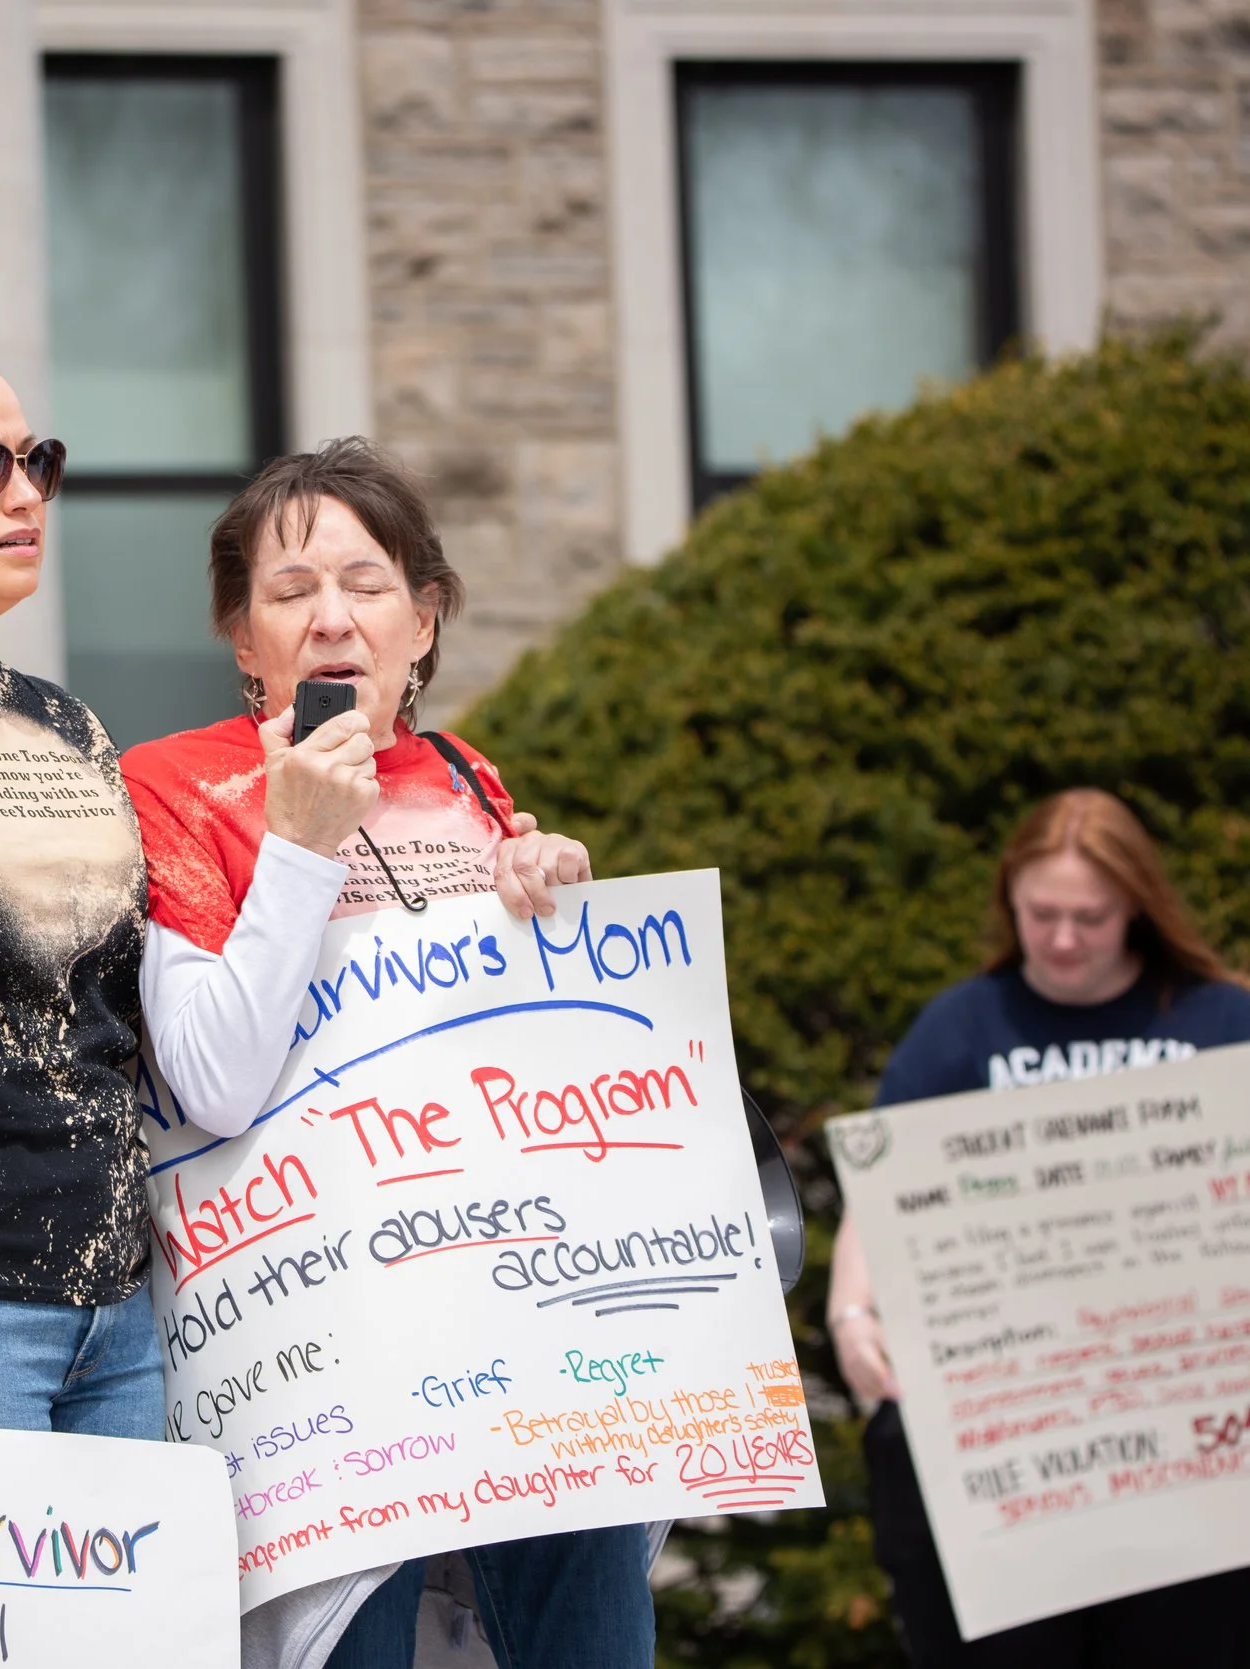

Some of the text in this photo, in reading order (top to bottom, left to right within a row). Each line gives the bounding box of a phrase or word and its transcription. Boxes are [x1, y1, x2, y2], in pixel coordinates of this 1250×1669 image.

[19, 750, 50, 763] Too
[33, 769, 84, 784] you're
[40, 787, 79, 800] with
[79, 789, 100, 798] us
[409, 840, 446, 854] Too
[290, 919, 507, 1051] urvivor's
[531, 900, 692, 992] Mom
[150, 1152, 318, 1283] Watch
[491, 1211, 763, 1291] accountable!
[163, 1195, 567, 1373] Hold their abusers
[196, 1361, 268, 1439] gave
[275, 1333, 341, 1382] me:
[626, 1396, 674, 1428] by
[670, 1388, 740, 1417] those
[252, 1404, 355, 1460] issues
[744, 1407, 800, 1433] safety
[343, 1432, 455, 1476] sorrow
[339, 1501, 410, 1533] from
[417, 1492, 471, 1522] my
[474, 1463, 605, 1508] daughter
[615, 1455, 658, 1486] for
[676, 1443, 727, 1484] 20
